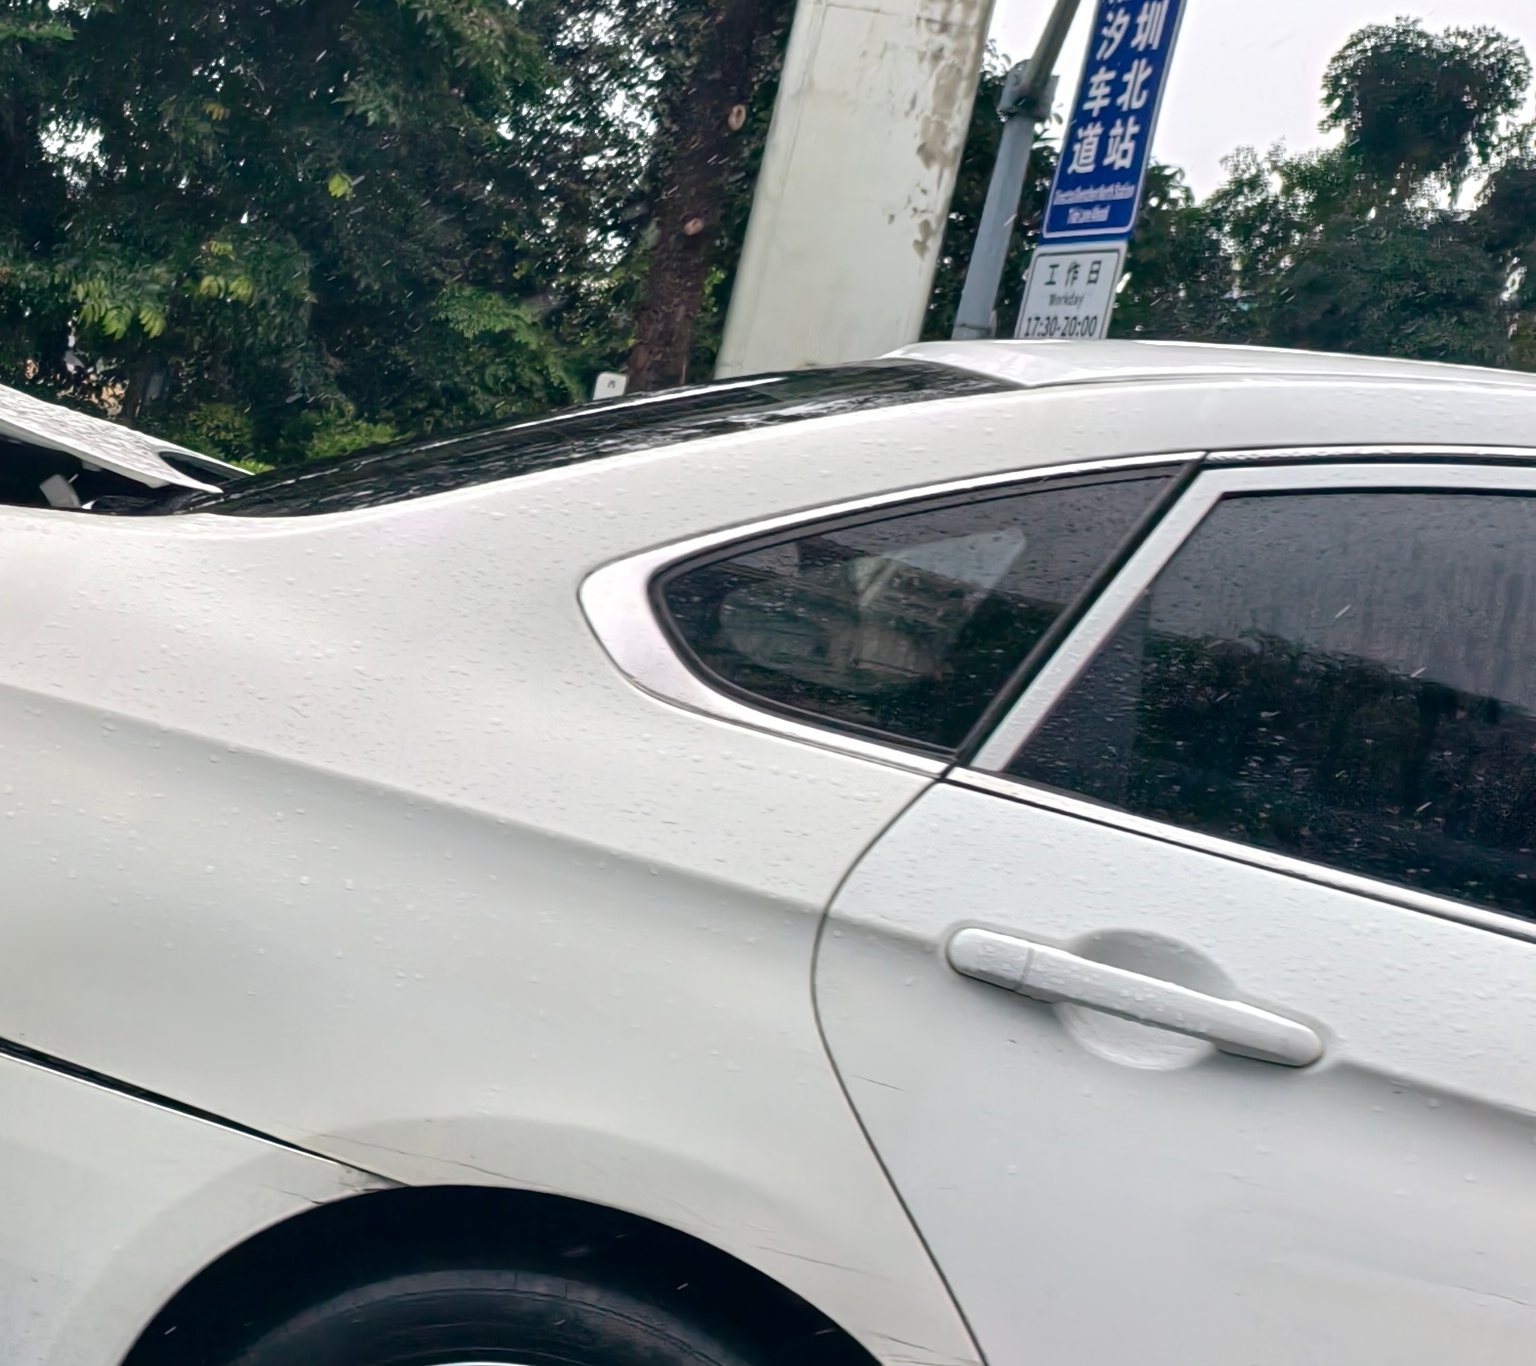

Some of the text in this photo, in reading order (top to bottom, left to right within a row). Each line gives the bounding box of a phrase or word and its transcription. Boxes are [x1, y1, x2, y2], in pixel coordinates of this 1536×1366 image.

[1044, 260, 1102, 287] 工作日
[1025, 316, 1098, 337] 17:30-20:00
